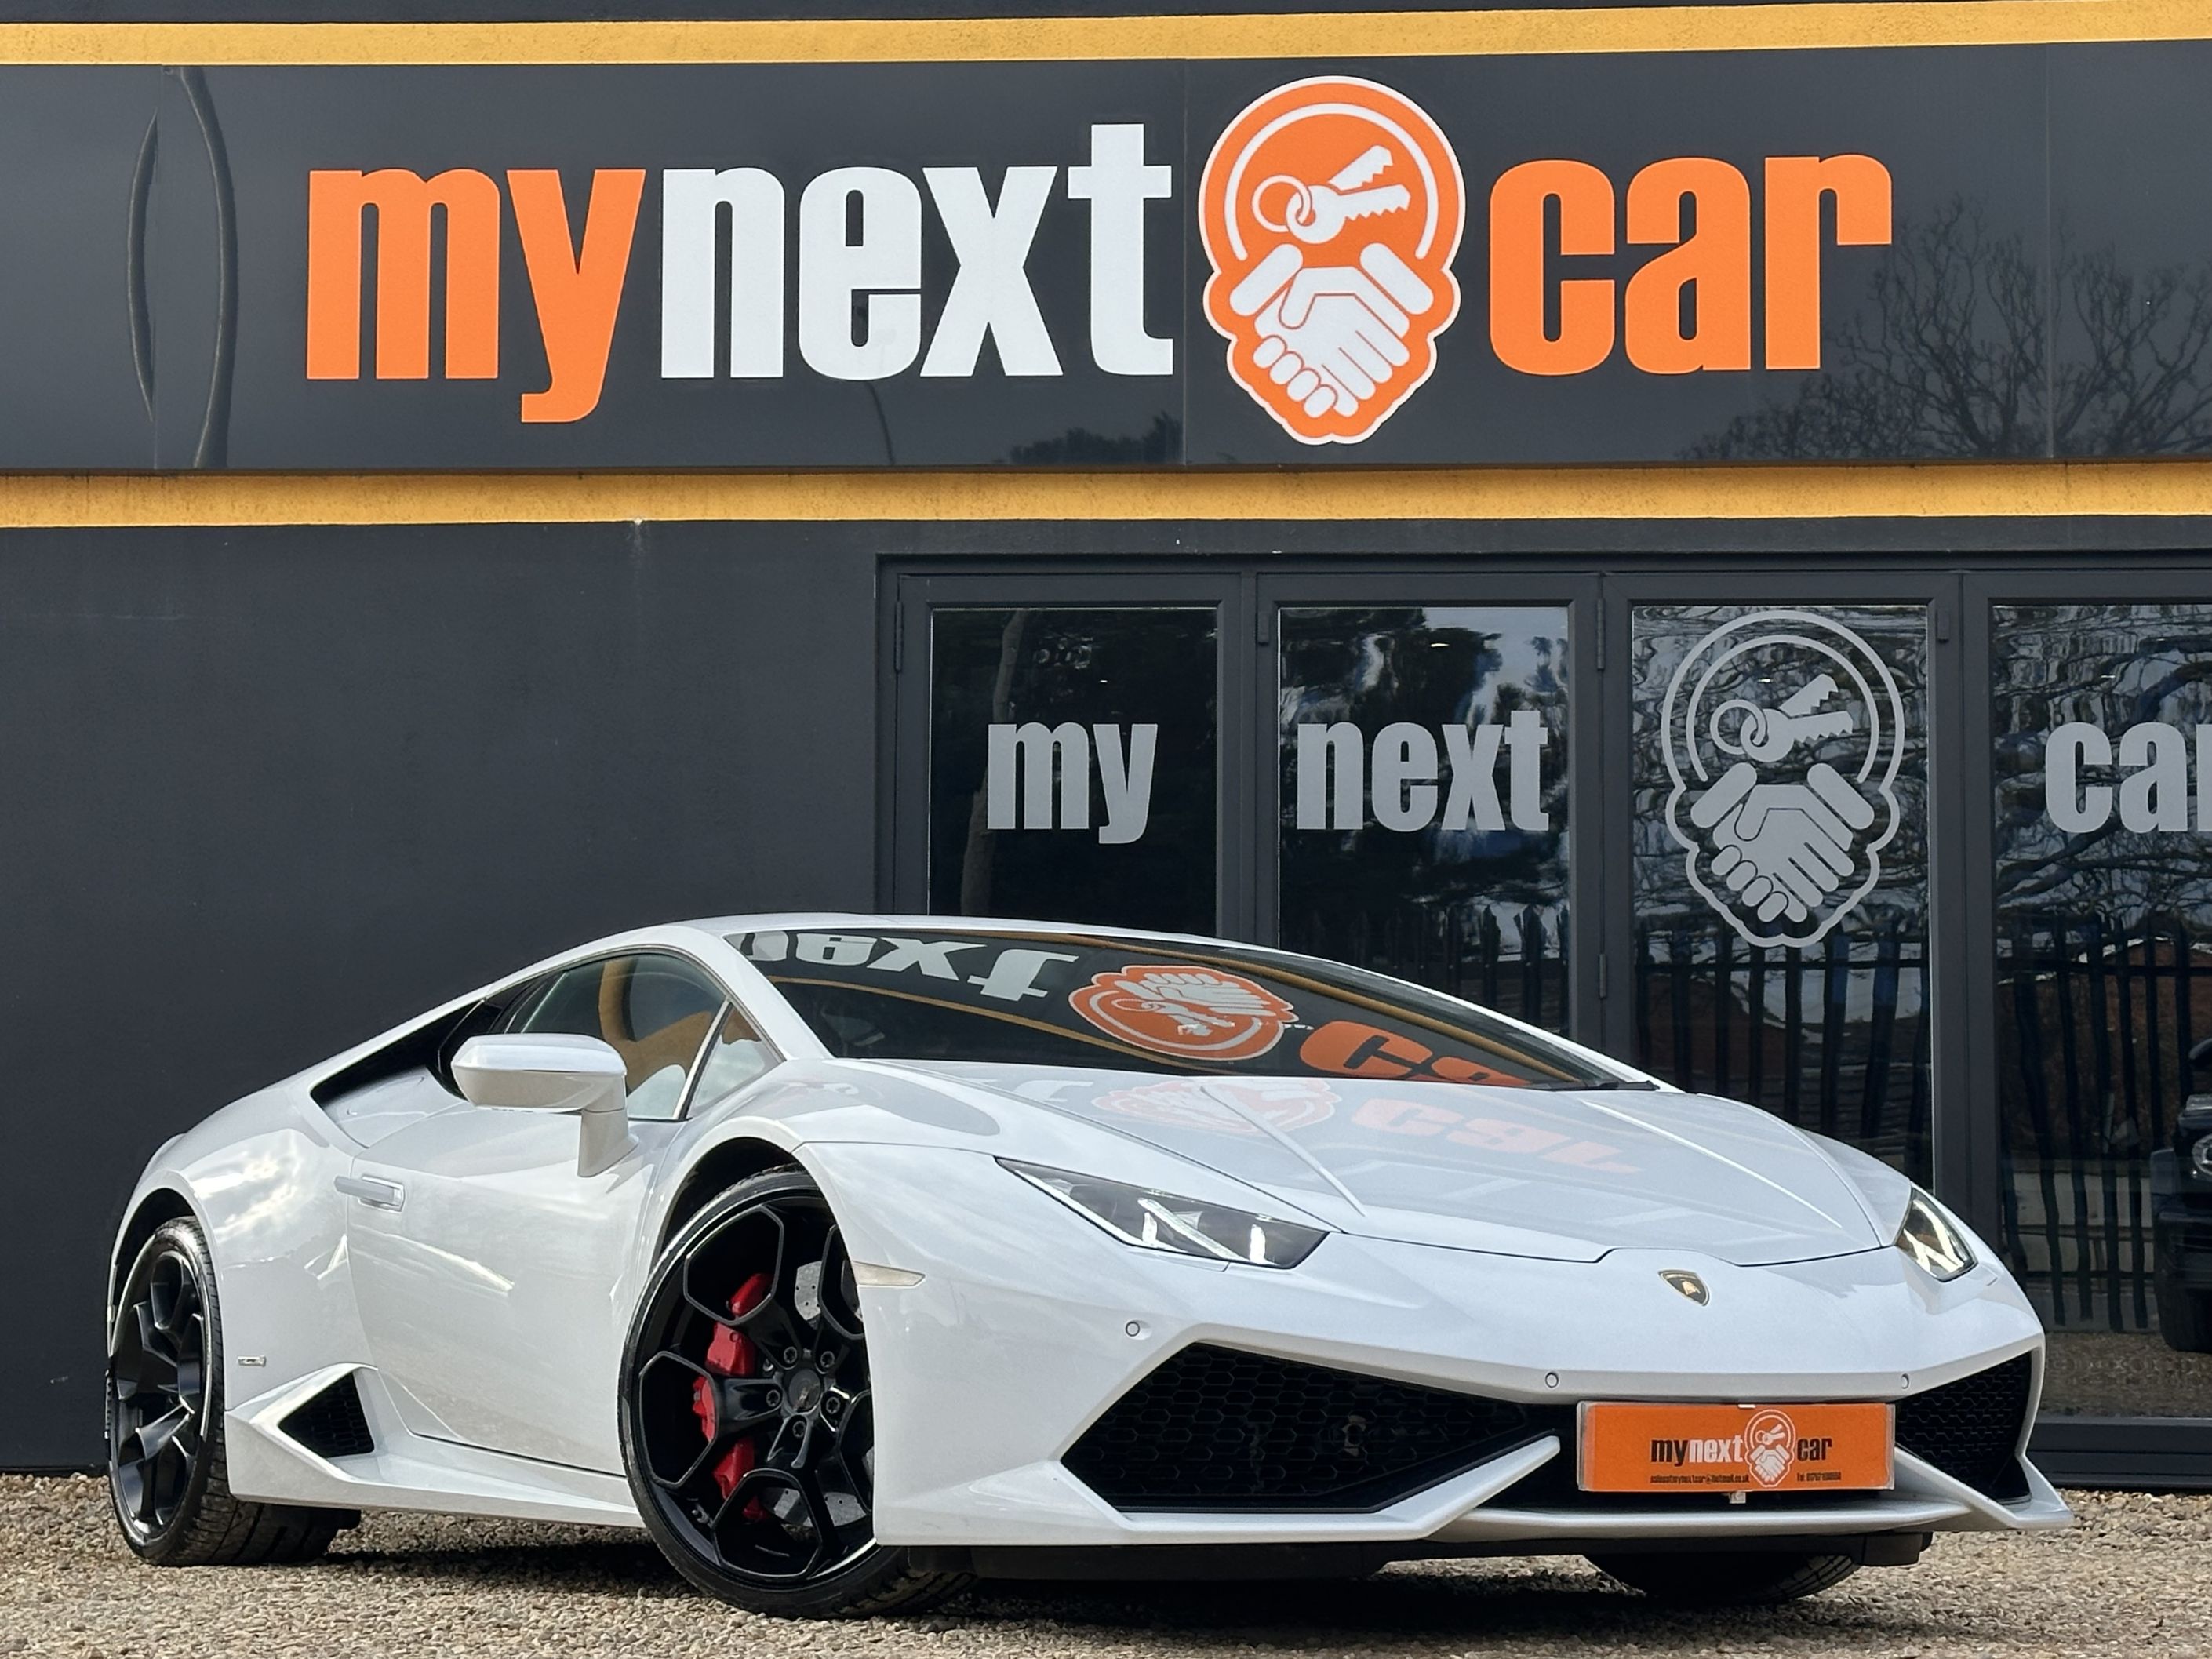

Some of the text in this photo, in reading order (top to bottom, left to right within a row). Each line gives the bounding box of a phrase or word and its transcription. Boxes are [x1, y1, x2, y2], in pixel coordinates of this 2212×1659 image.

[1490, 154, 1892, 376] car
[987, 722, 1158, 844] my
[1297, 710, 1549, 831] next
[1796, 1436, 1833, 1461] car
